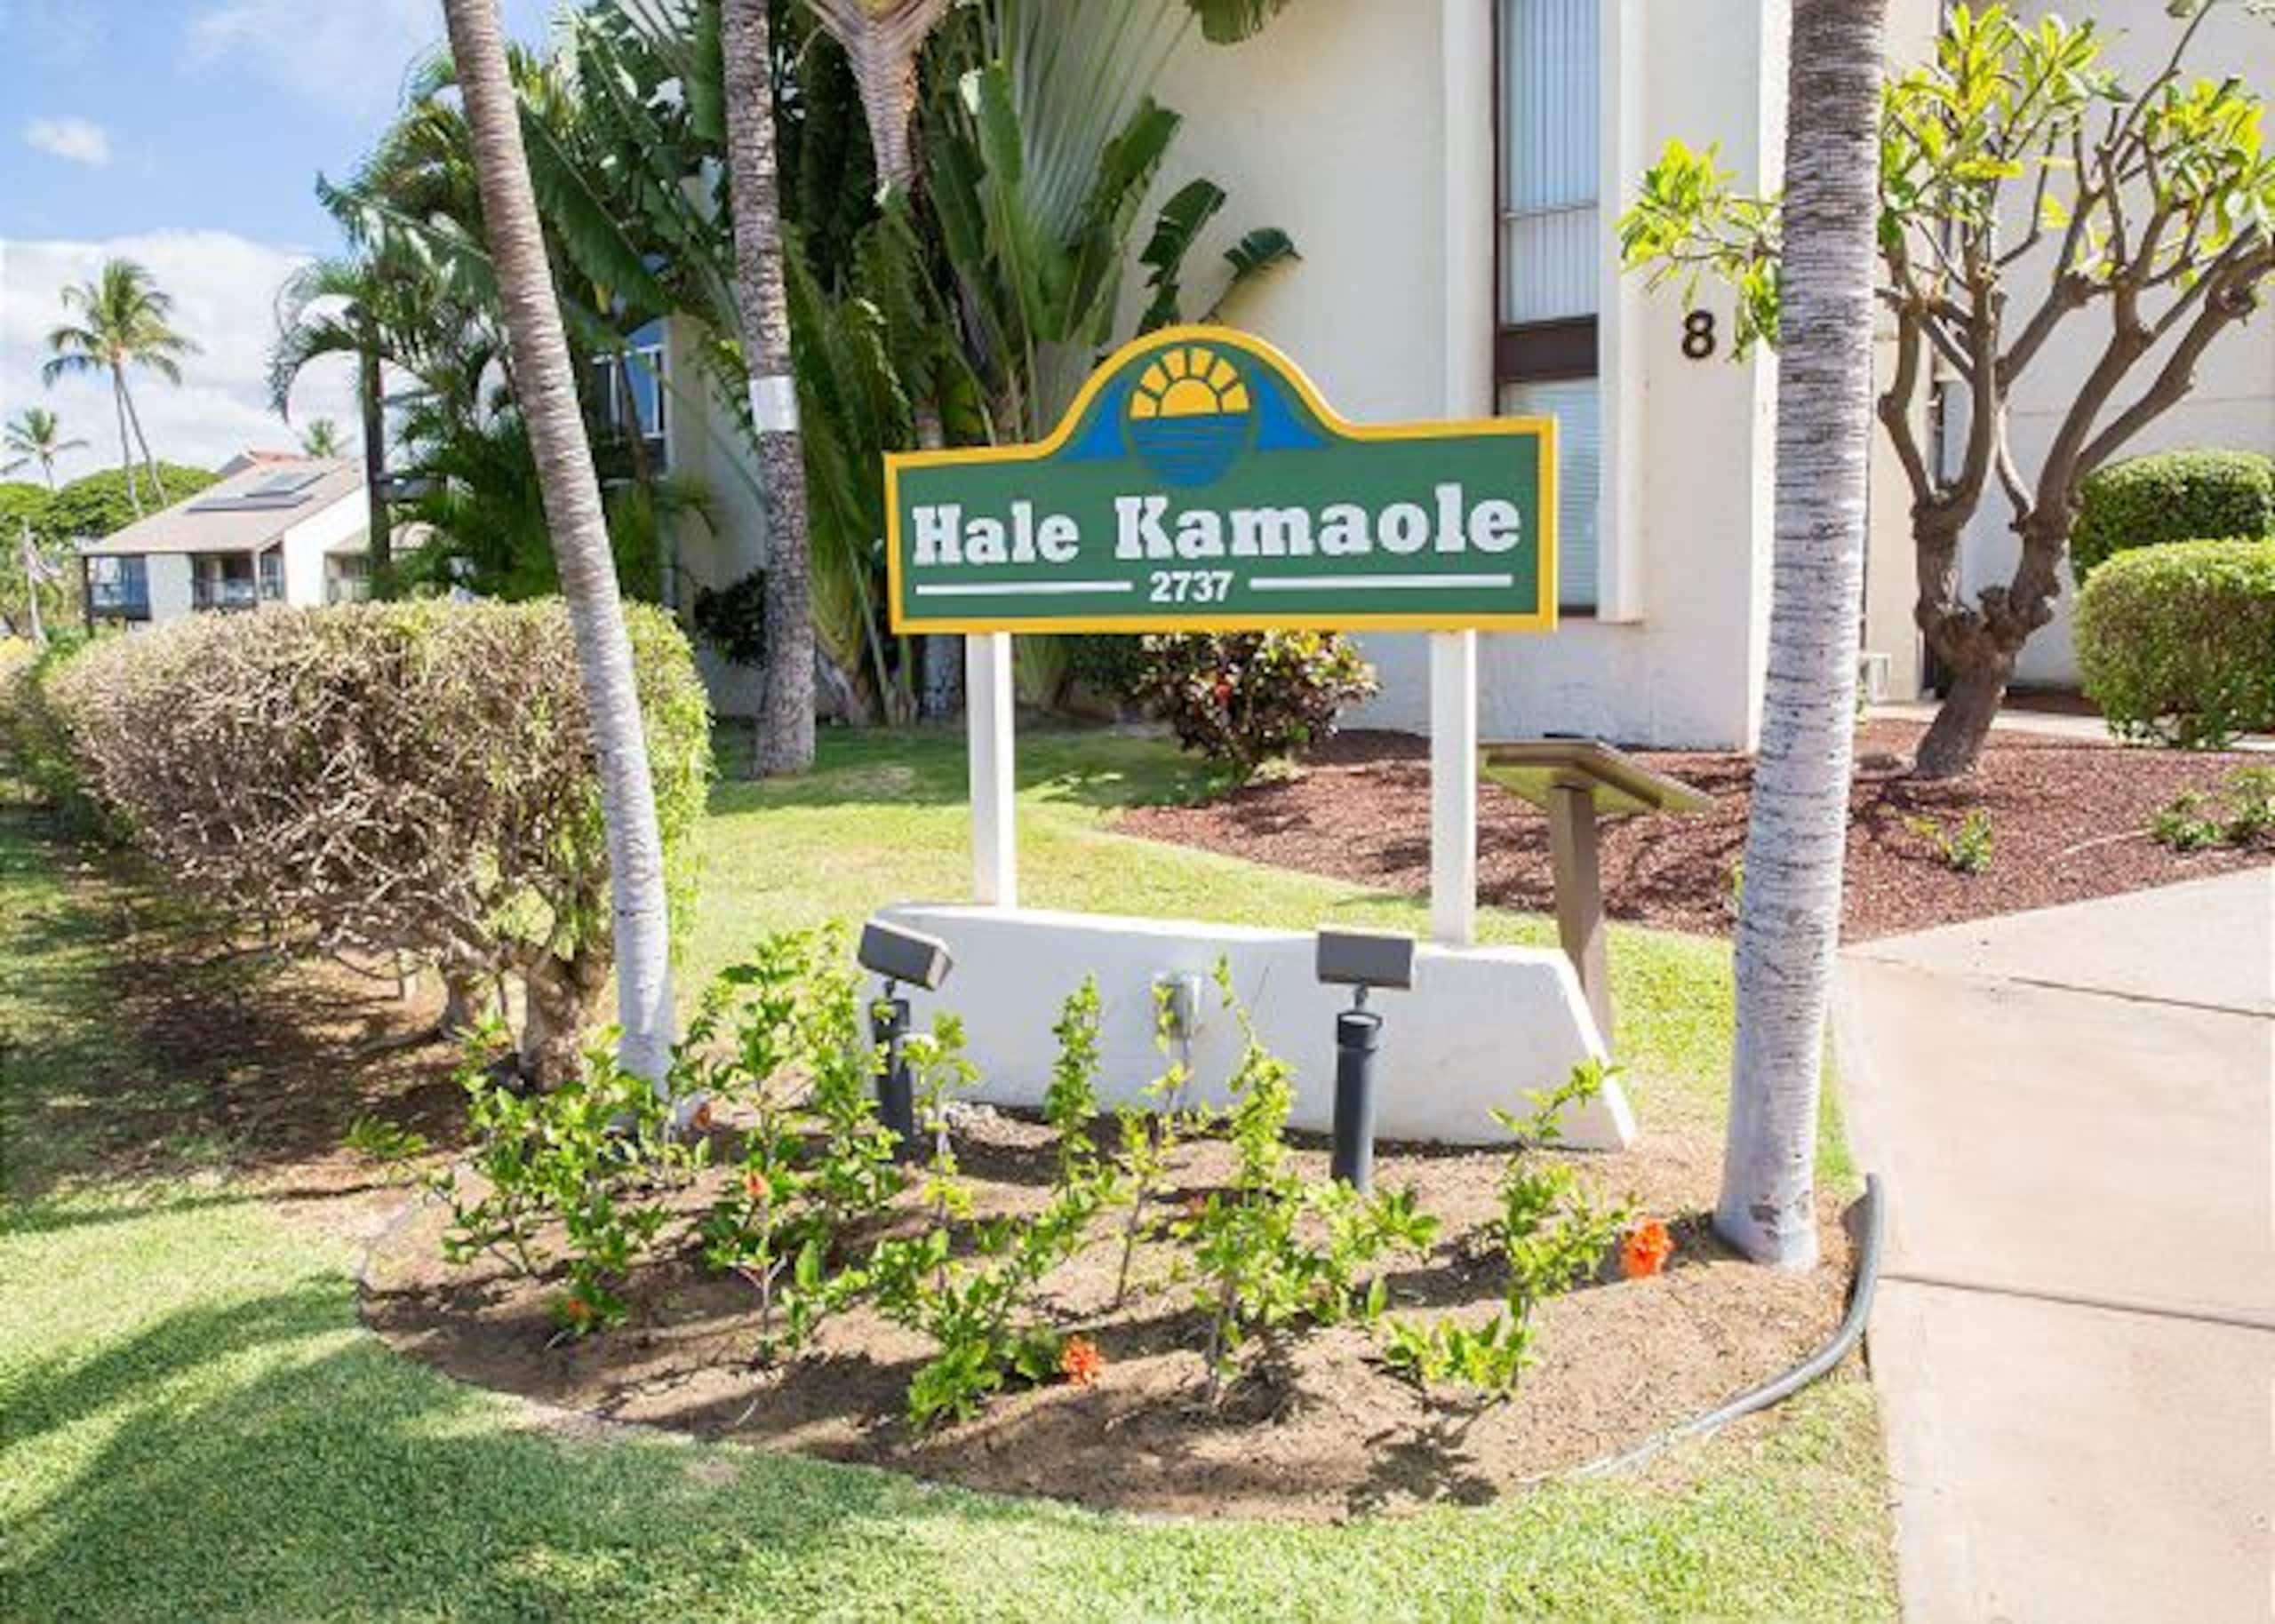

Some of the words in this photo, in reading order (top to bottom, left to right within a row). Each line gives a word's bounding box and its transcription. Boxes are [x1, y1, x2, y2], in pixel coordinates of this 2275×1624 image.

[1682, 309, 1716, 359] 8
[913, 501, 1079, 565] Hale
[1114, 483, 1521, 560] Kamaole
[1150, 571, 1233, 603] 2737
